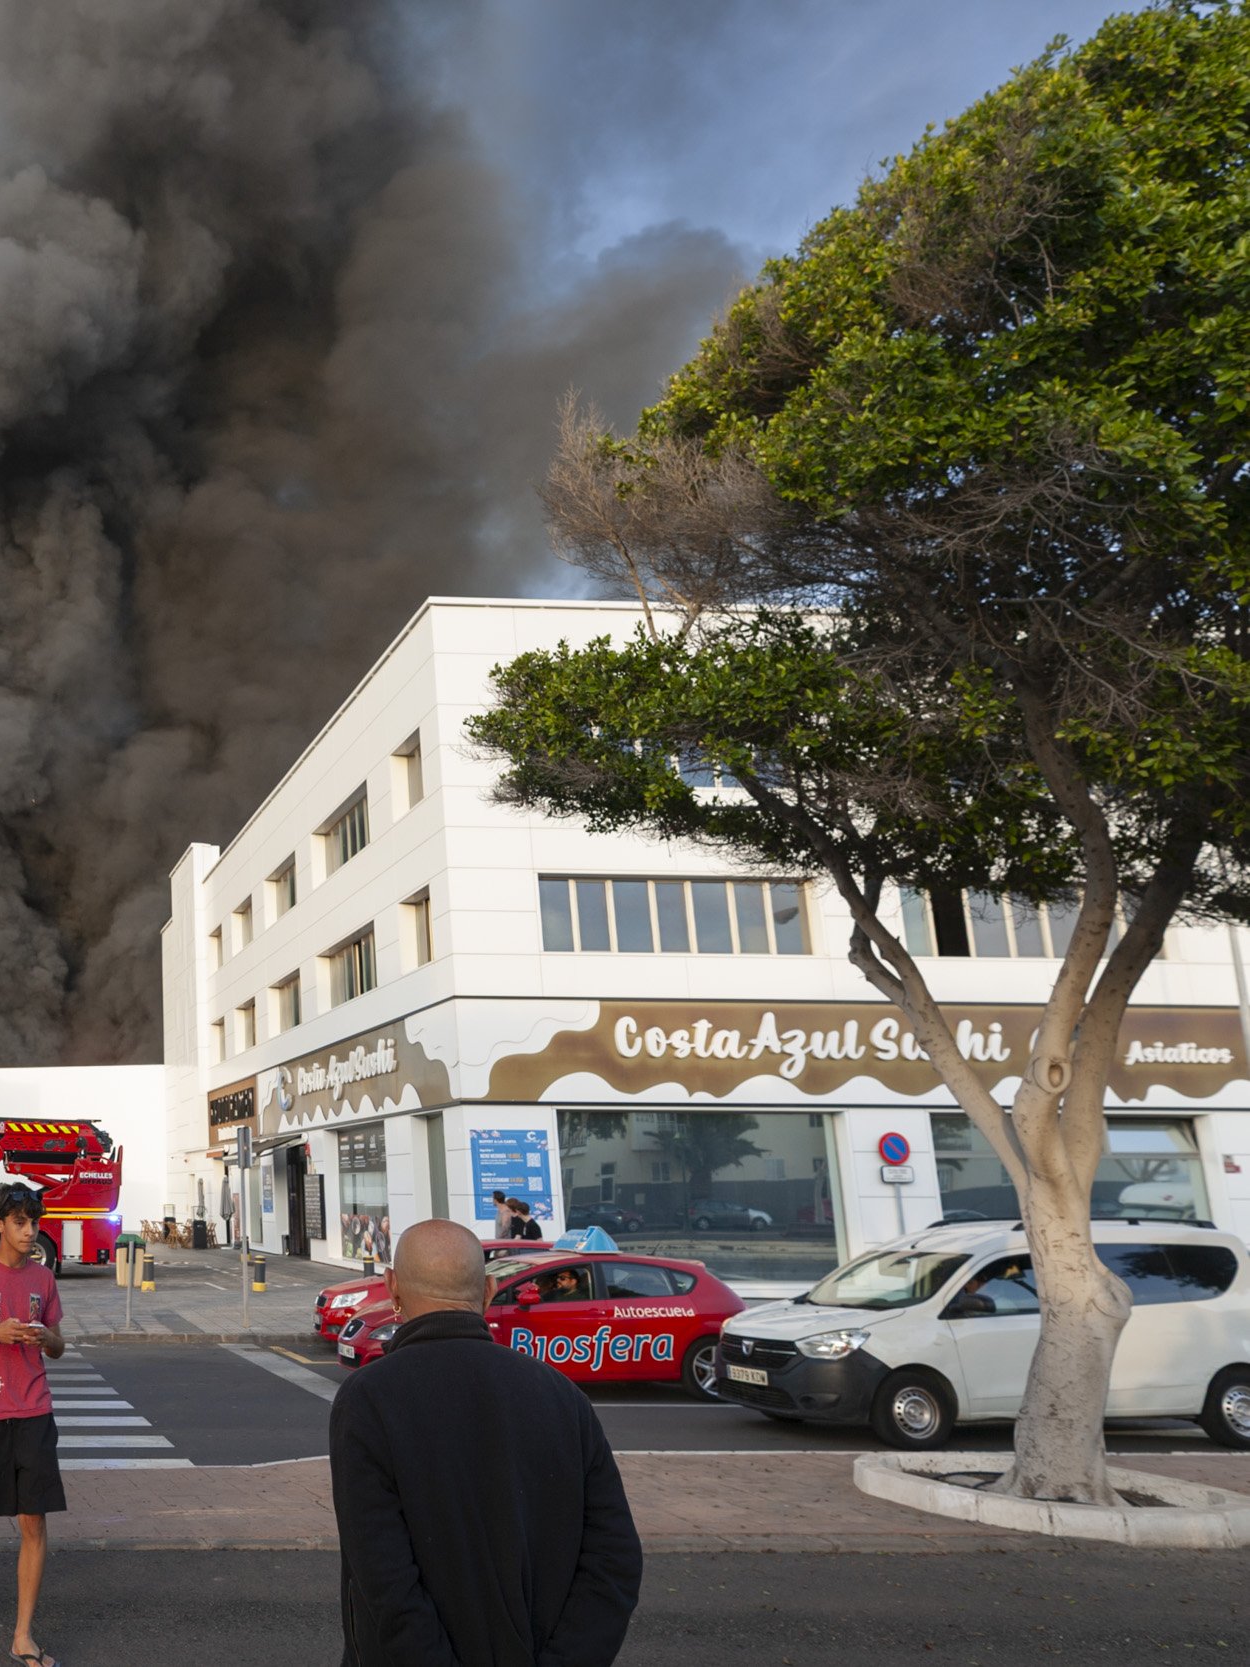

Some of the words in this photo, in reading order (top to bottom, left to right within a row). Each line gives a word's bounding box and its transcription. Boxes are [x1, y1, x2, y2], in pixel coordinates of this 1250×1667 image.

[297, 1062, 326, 1096] Costa
[326, 1051, 355, 1101] Azul
[355, 1038, 397, 1081] Sushi
[614, 1015, 748, 1059] Costa
[748, 1011, 866, 1080] Azul
[869, 1017, 1011, 1062] Suhi
[613, 1305, 695, 1318] Autoescuela
[510, 1325, 675, 1372] Biosfera
